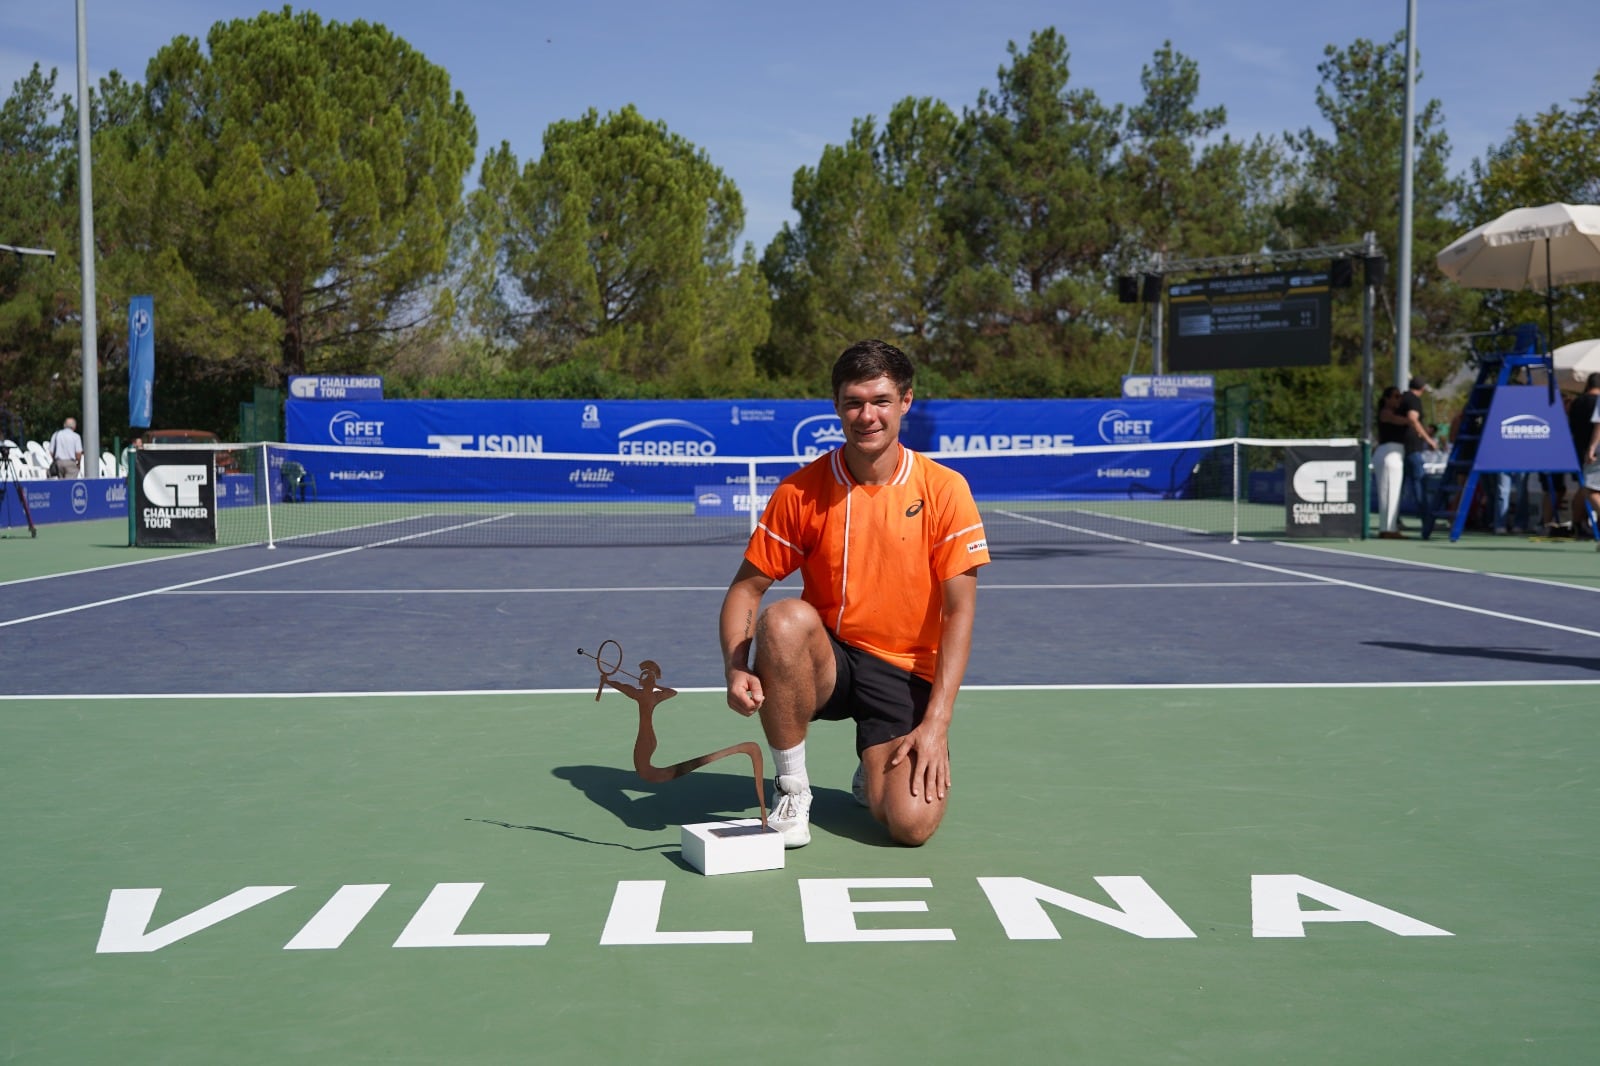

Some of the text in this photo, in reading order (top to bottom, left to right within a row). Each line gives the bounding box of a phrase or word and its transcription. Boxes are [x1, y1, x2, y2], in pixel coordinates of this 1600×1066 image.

[320, 377, 381, 388] CHALLENGER
[1152, 377, 1213, 388] CHALLENGER
[320, 388, 346, 398] TOUR
[1153, 387, 1178, 397] TOUR
[344, 421, 384, 436] RFET
[1113, 420, 1153, 435] RFET
[1501, 424, 1550, 435] FERRERO
[618, 440, 717, 457] FERRERO
[143, 507, 208, 518] CHALLENGER
[1292, 503, 1356, 514] CHALLENGER
[143, 518, 172, 528] TOUR
[1293, 513, 1321, 524] TOUR
[95, 874, 1455, 954] VILLENA
